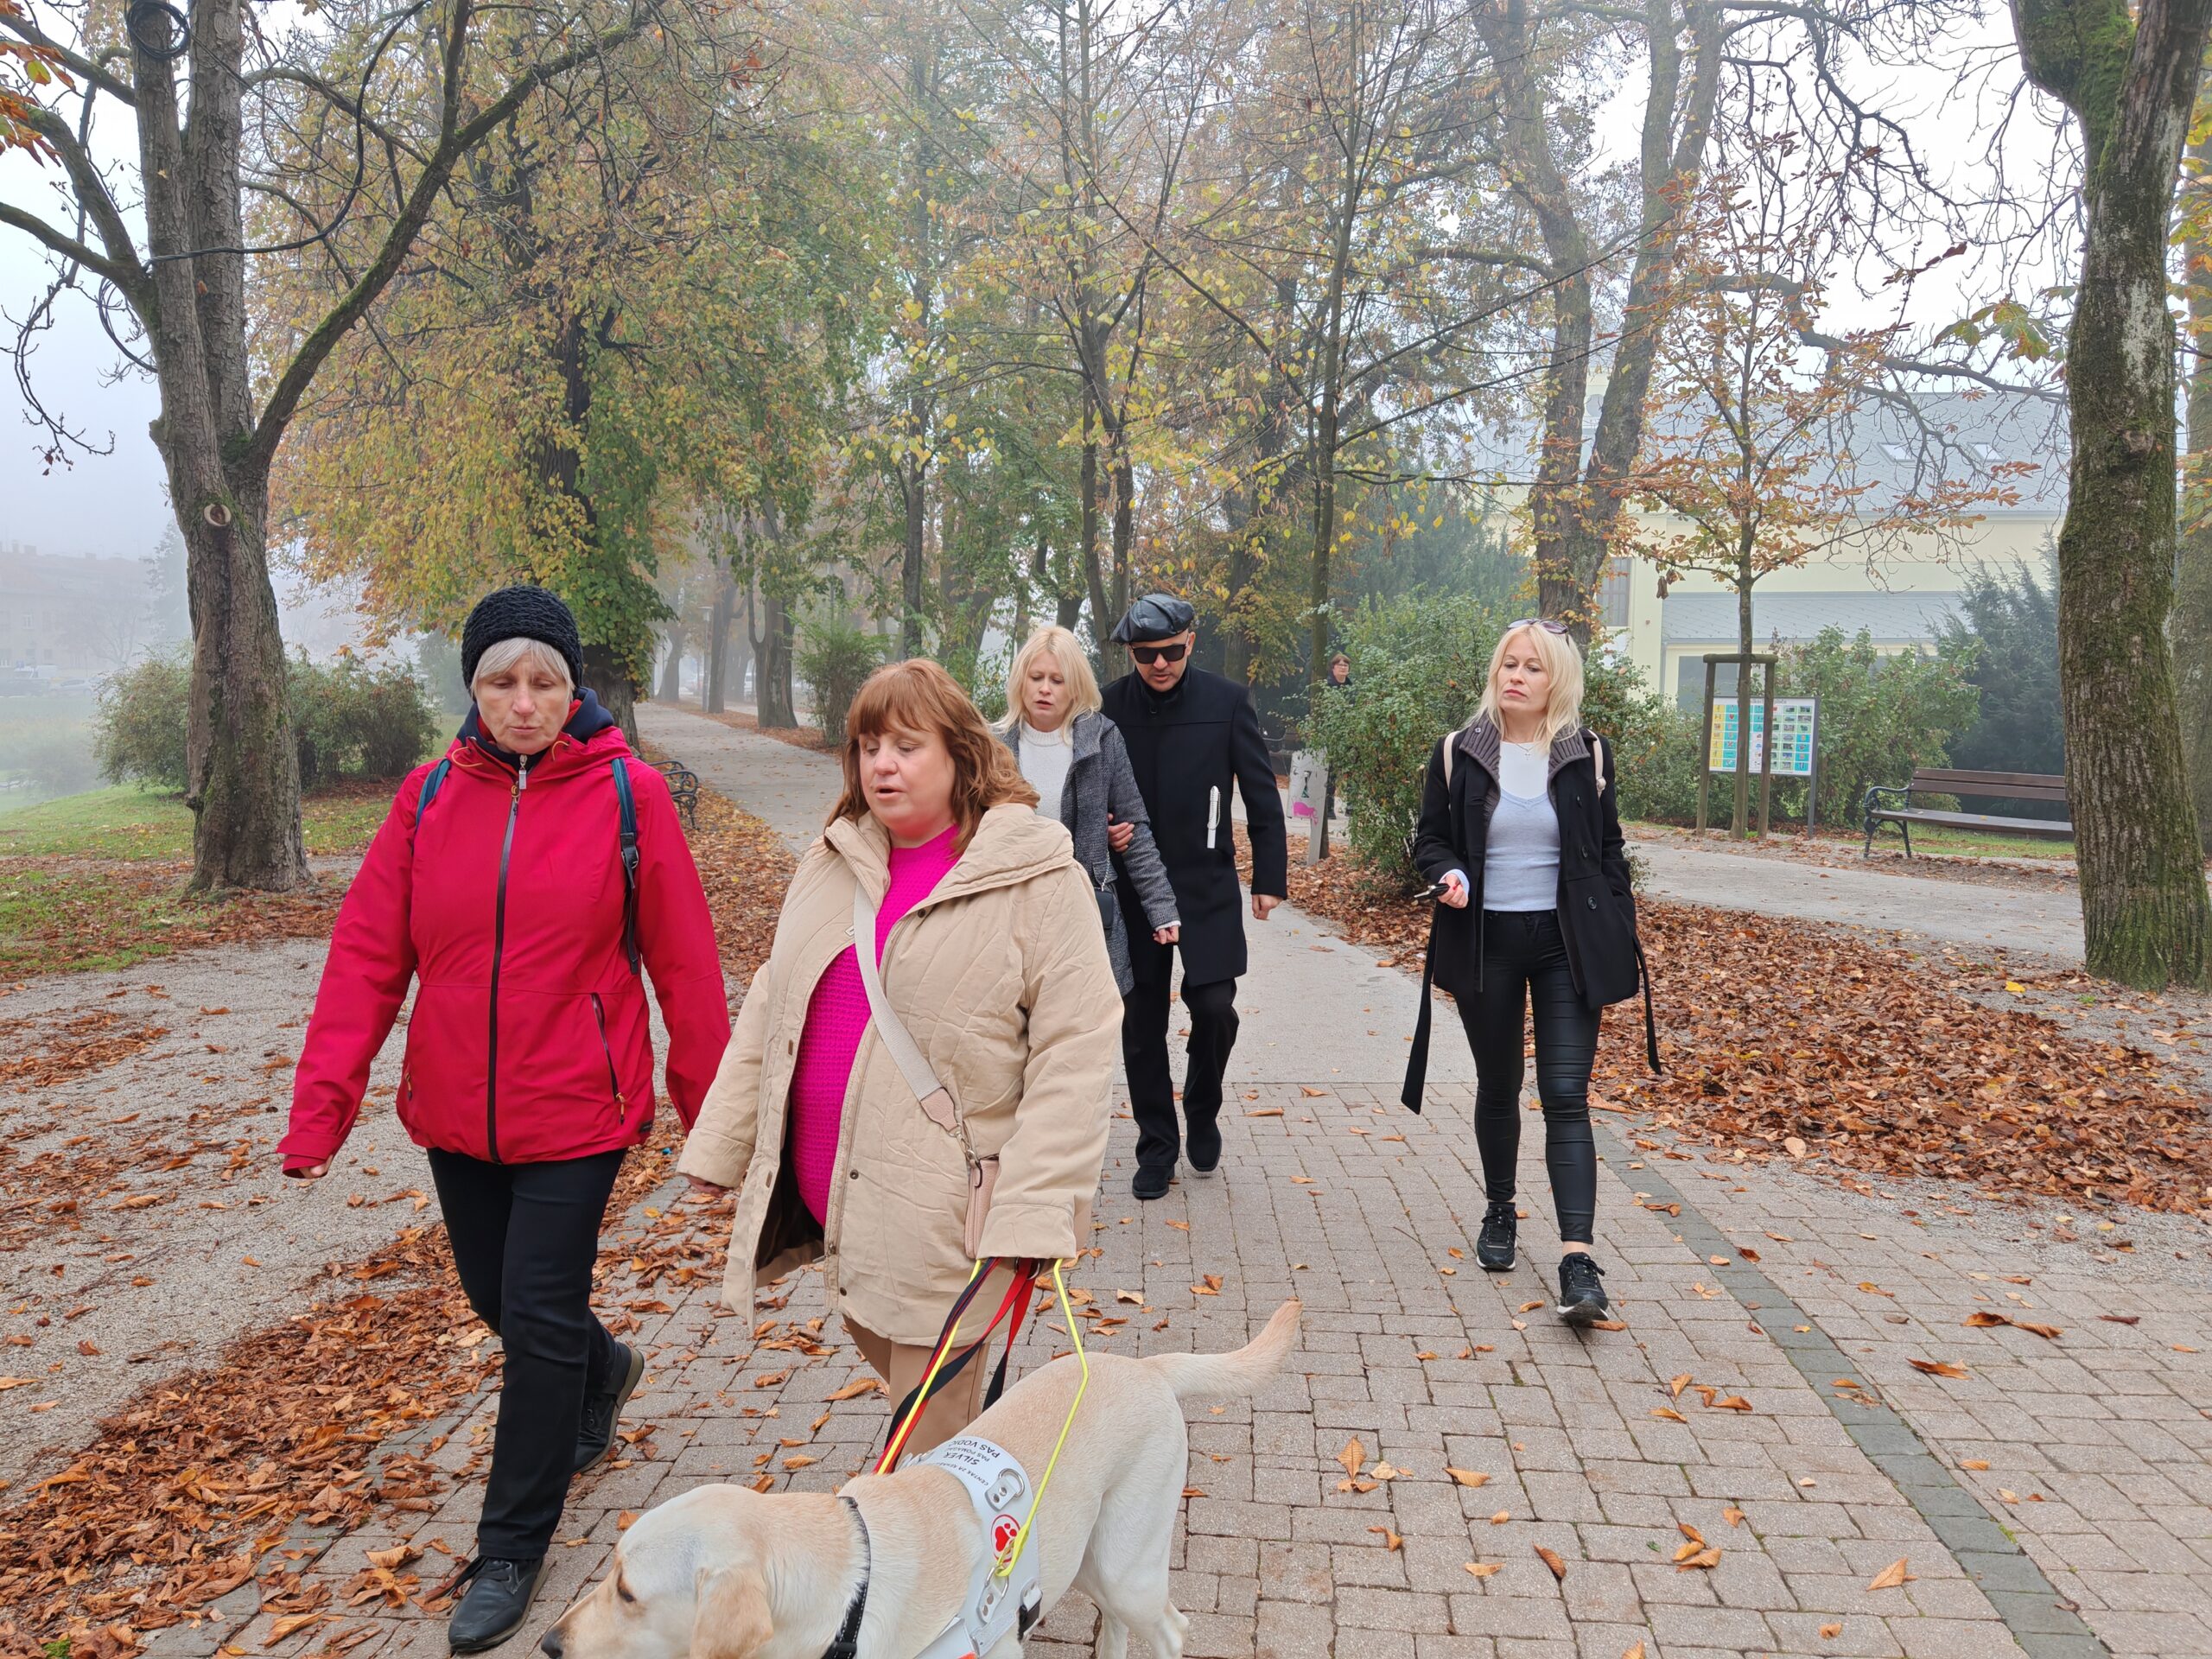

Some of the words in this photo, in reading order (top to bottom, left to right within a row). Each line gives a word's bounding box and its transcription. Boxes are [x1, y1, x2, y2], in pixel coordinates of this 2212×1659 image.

[976, 1452, 990, 1462] PAS
[979, 1444, 1001, 1459] PAS
[943, 1452, 980, 1465] SILVER
